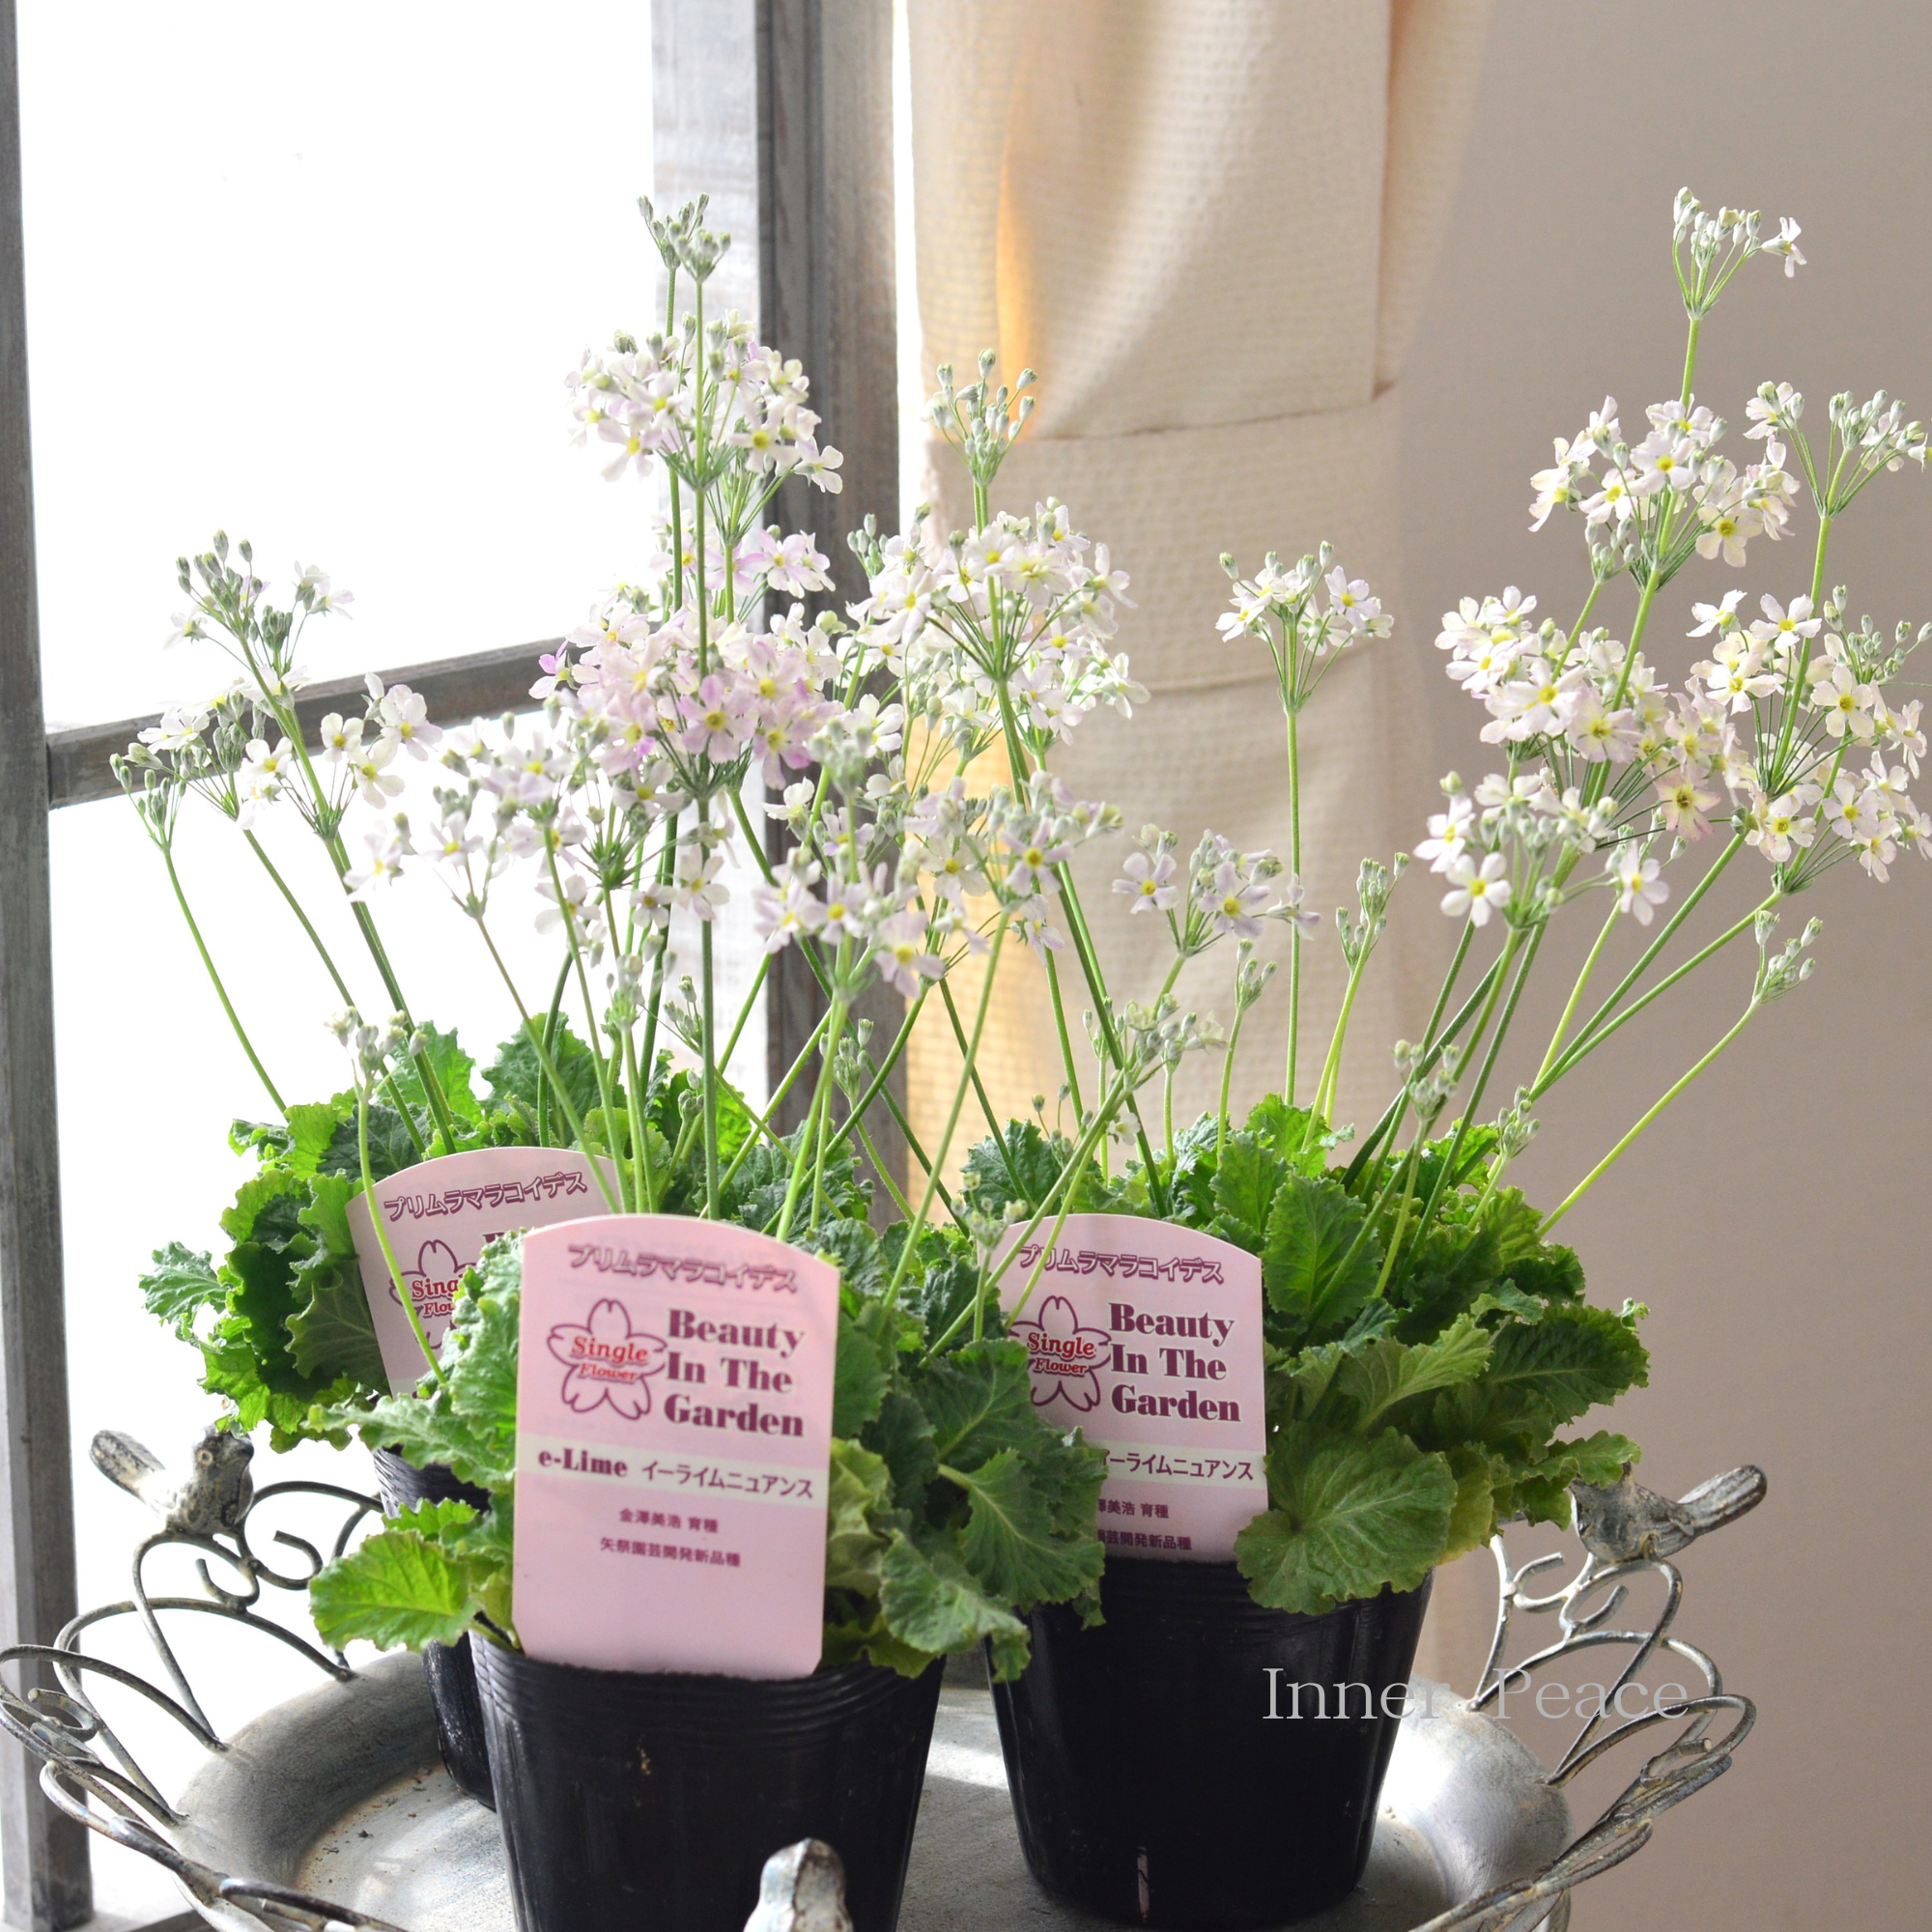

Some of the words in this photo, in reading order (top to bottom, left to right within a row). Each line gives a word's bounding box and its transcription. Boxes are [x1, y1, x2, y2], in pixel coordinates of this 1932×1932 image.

[384, 1171, 587, 1222] プリムラマラコイデス
[568, 1243, 797, 1294] プリムラマラコイデス
[1019, 1244, 1224, 1285] プリムラマラコイデス
[412, 1274, 463, 1301] Sing
[423, 1301, 455, 1318] Flo
[1108, 1302, 1235, 1347] Beauty
[570, 1335, 649, 1366] Single
[668, 1307, 805, 1358] Beauty
[1026, 1331, 1096, 1358] Single
[578, 1361, 639, 1385] Flower
[667, 1351, 705, 1384] In
[720, 1356, 793, 1393] The
[1032, 1356, 1089, 1378] Flower
[1111, 1344, 1149, 1375] In
[1159, 1348, 1227, 1380] The
[664, 1393, 805, 1437] Garden
[1111, 1383, 1241, 1422] Garden
[538, 1447, 628, 1478] e-Lime
[641, 1460, 813, 1499] イーライムニュアンス
[688, 1516, 719, 1533] 育種
[1097, 1497, 1135, 1517] 澤美浩
[1140, 1502, 1170, 1520] 育種
[1096, 1528, 1192, 1551] 園芸開発新品種
